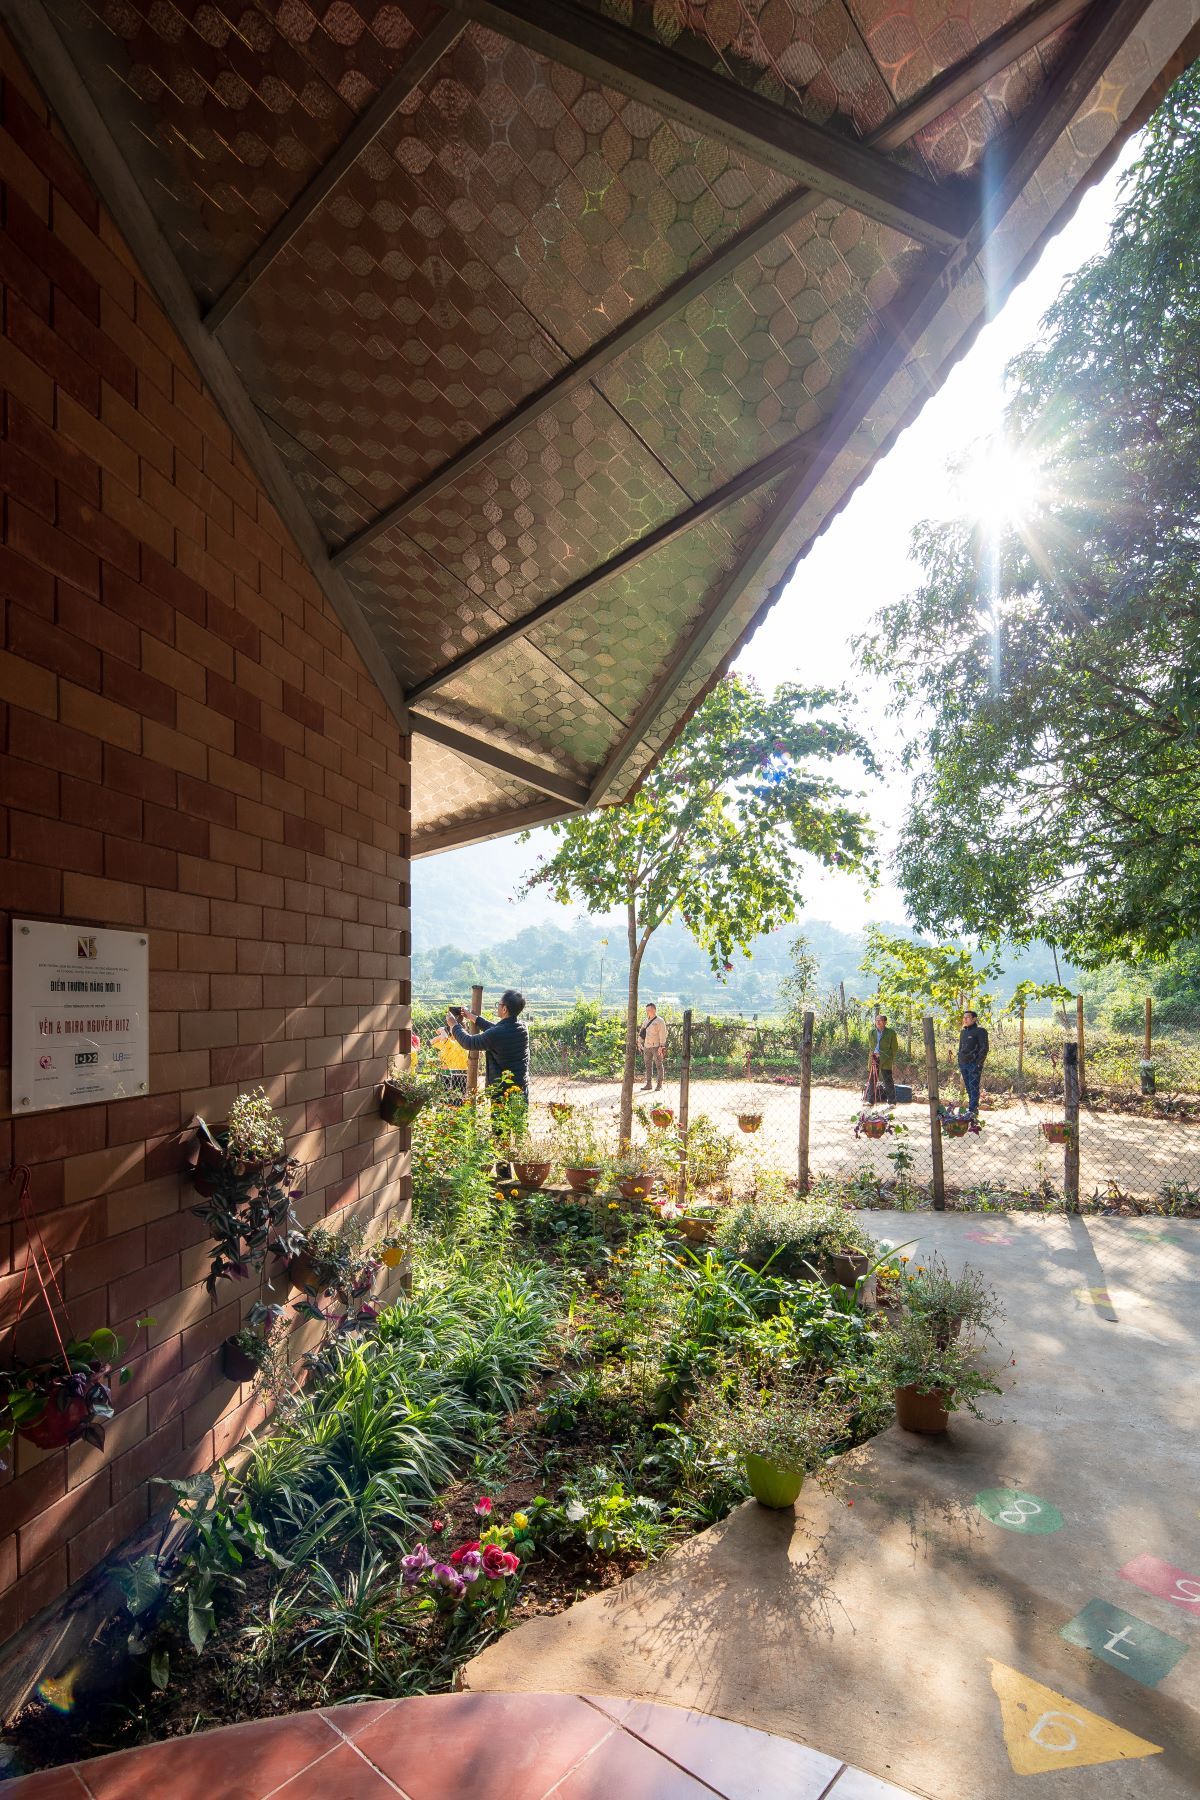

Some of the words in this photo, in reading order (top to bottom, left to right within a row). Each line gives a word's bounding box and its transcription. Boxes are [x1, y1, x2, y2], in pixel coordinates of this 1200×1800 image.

[56, 1020, 62, 1034] &
[64, 1019, 84, 1034] MIRA
[999, 1499, 1042, 1525] 8
